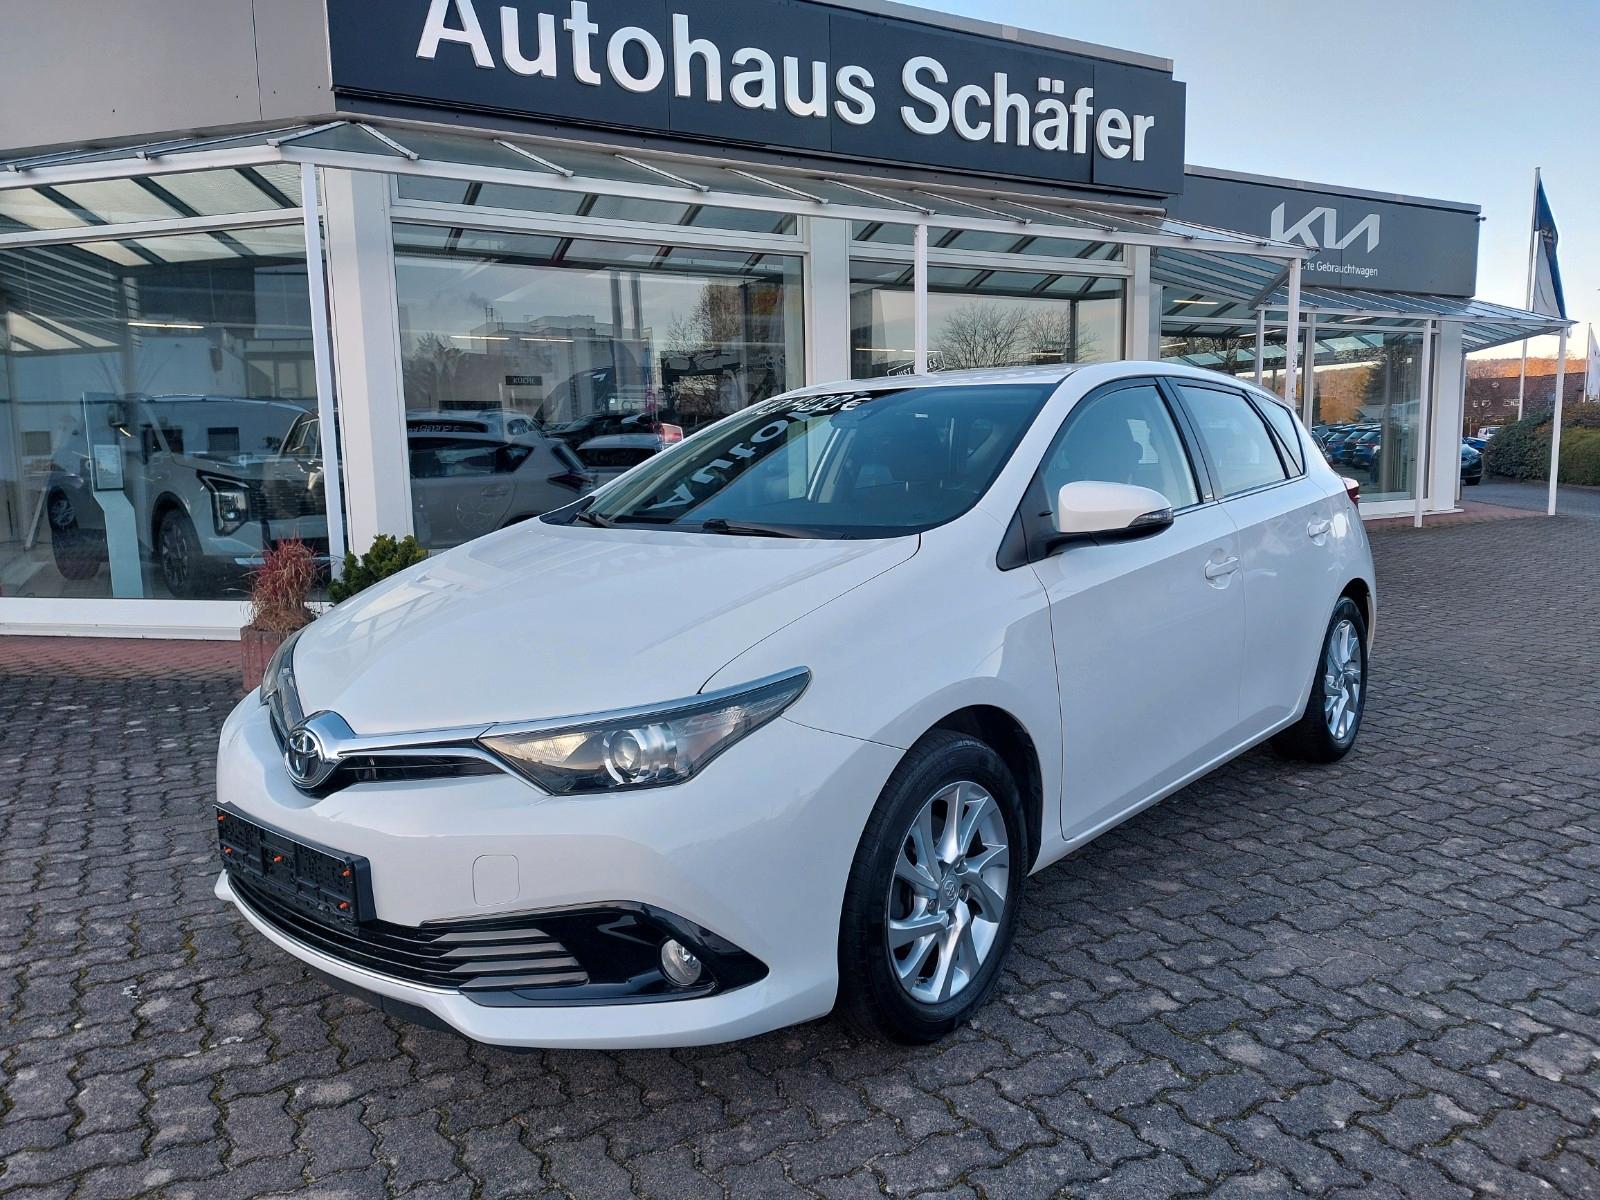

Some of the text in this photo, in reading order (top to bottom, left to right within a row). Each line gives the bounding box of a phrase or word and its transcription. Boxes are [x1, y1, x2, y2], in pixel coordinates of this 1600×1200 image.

[415, 0, 1154, 161] Autohaus Schäfer
[1270, 201, 1380, 253] KIA
[1316, 261, 1378, 278] Gebrauchtwagen
